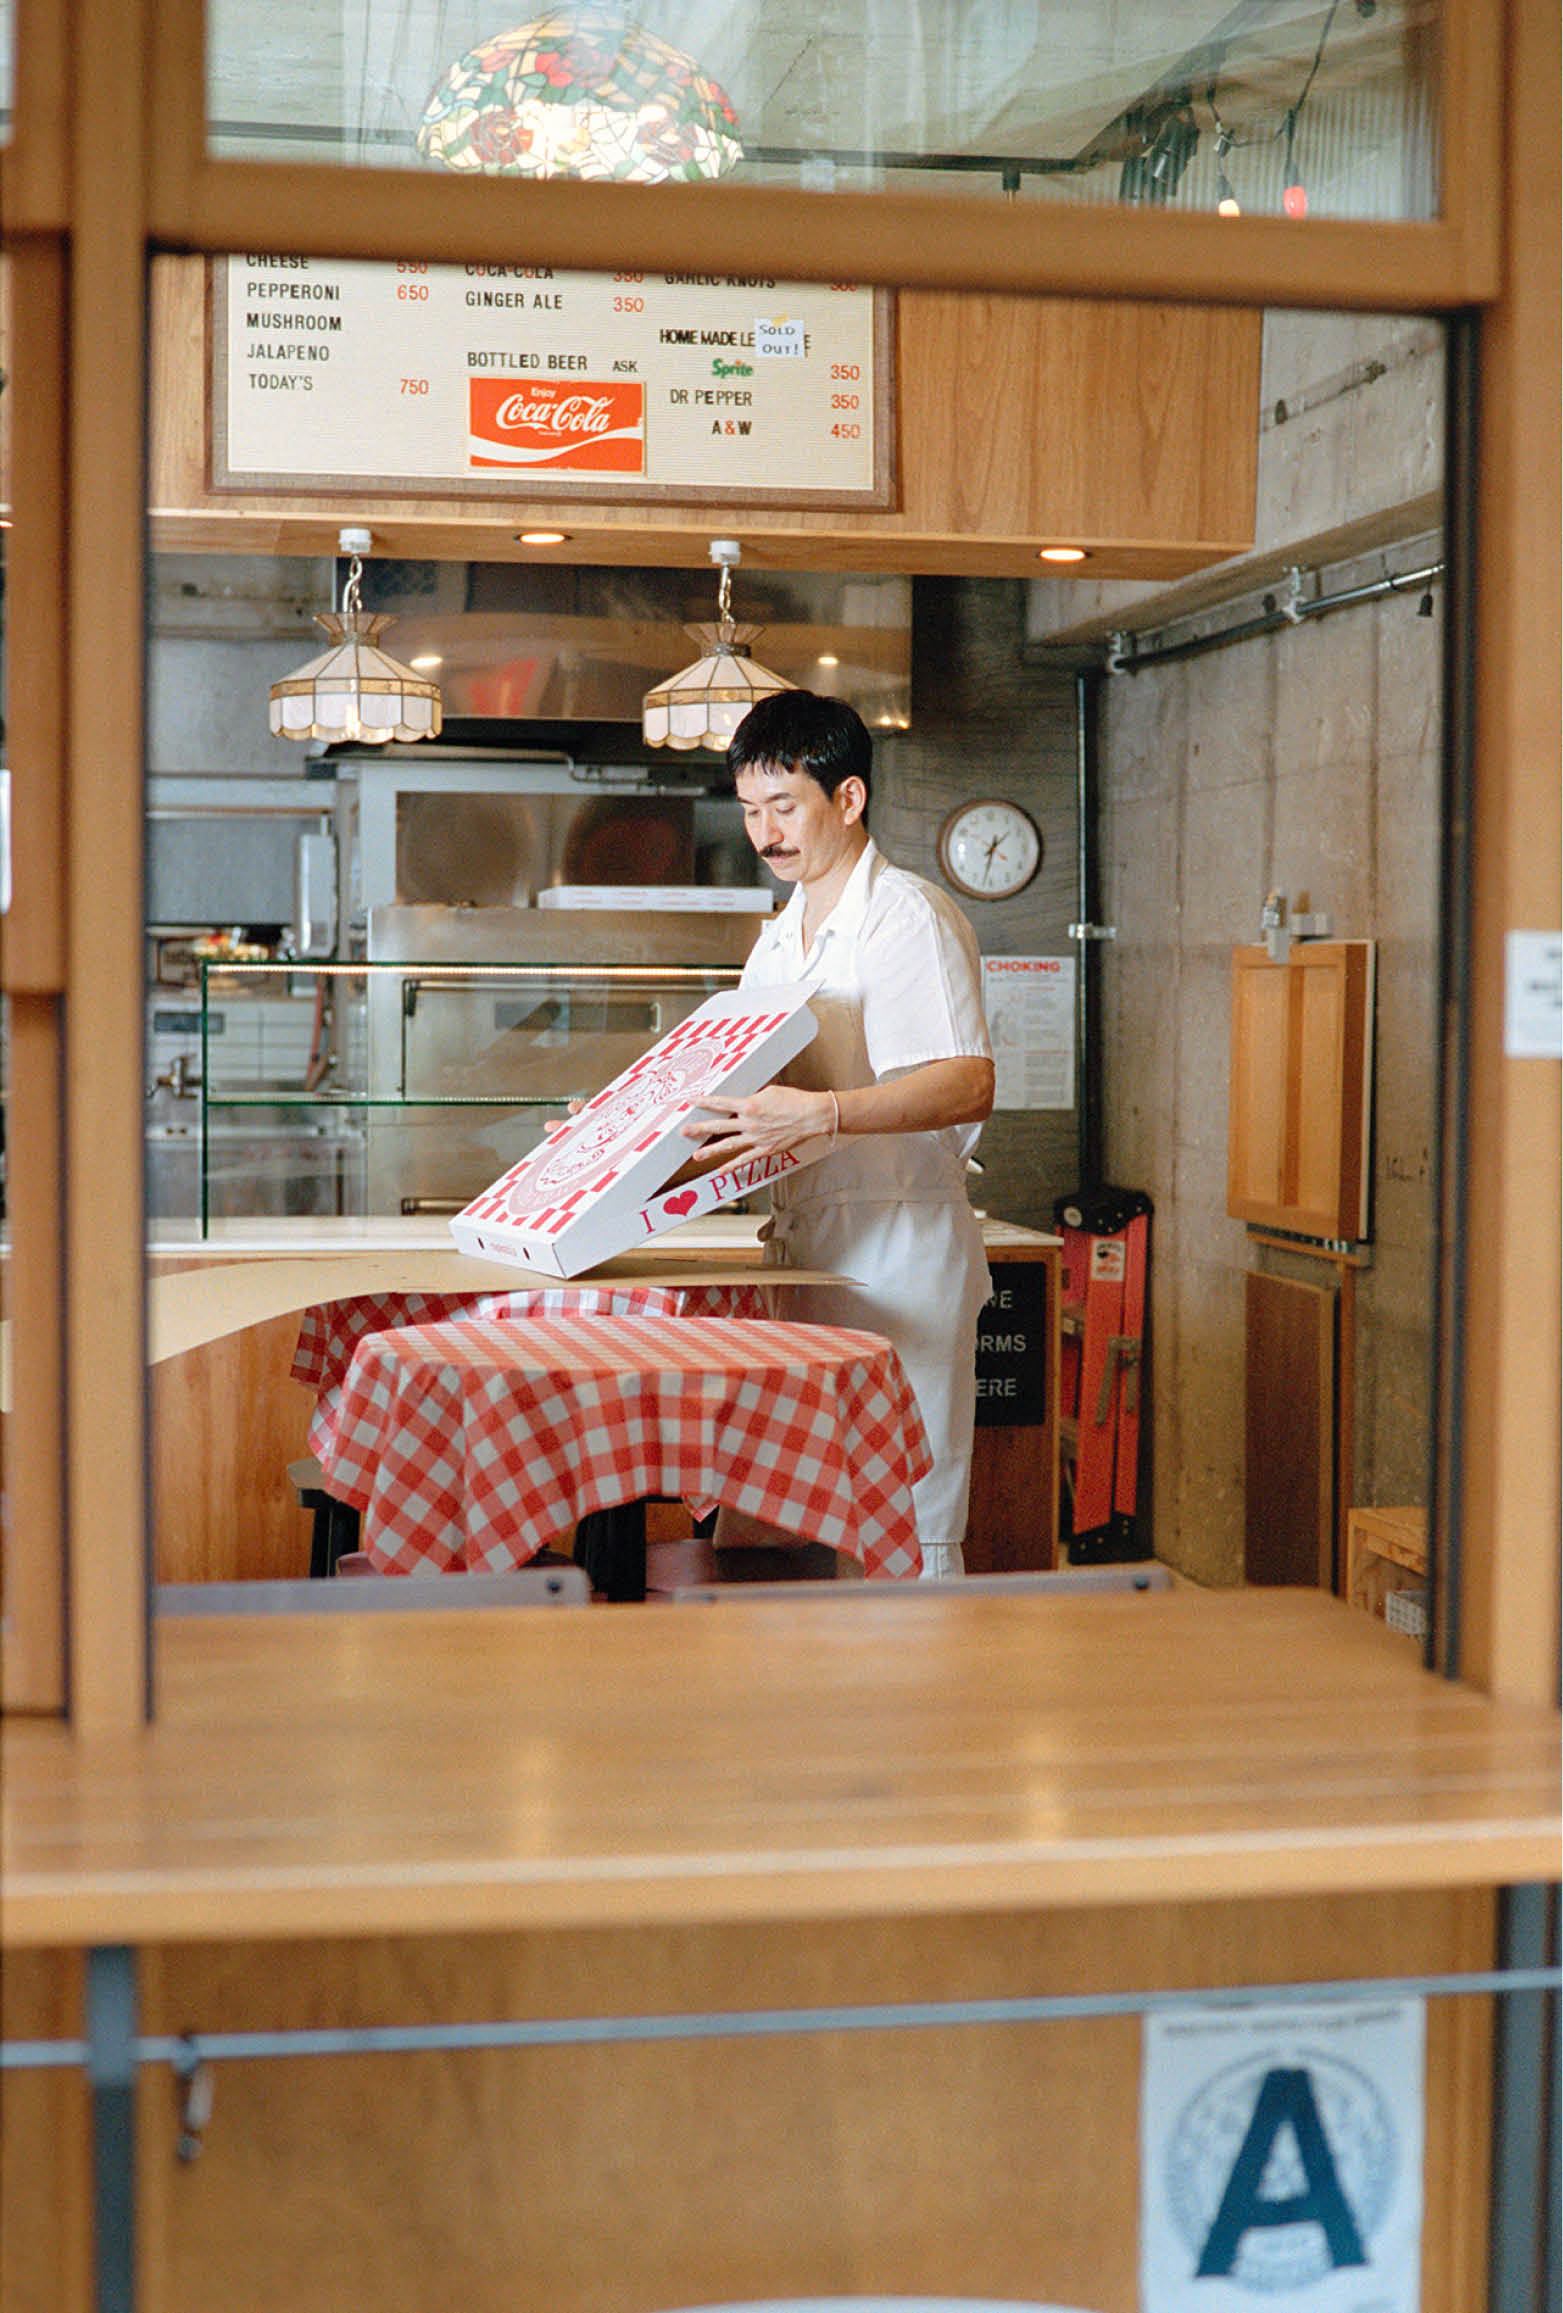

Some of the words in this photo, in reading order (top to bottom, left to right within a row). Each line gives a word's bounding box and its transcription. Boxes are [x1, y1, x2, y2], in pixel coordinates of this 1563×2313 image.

[246, 254, 309, 269] CHEESE
[465, 264, 554, 280] COCA-COLA
[664, 273, 720, 286] GARLIC
[247, 282, 340, 301] PEPPERONI
[397, 285, 429, 301] 650
[465, 291, 525, 308] GINGER
[533, 294, 563, 310] ALE
[613, 296, 644, 313] 350
[246, 312, 342, 331] MUSHROOM
[660, 329, 698, 344] HOME
[701, 331, 737, 347] MADE
[247, 343, 330, 361] JALAPENO
[762, 343, 799, 355] OUT!
[467, 352, 540, 369] BOTTLED
[548, 355, 588, 370] BEER
[612, 360, 638, 373] ASK
[712, 358, 753, 379] Sprite
[830, 364, 860, 381] 350
[249, 373, 313, 391] TODAY'S
[400, 378, 429, 395] 750
[530, 387, 556, 399] Enjoy
[670, 389, 688, 404] DR
[695, 390, 752, 406] PEPPER
[831, 393, 860, 410] 350
[495, 393, 615, 432] Coca-Cola
[831, 423, 861, 440] 450
[985, 960, 1061, 973] CHOKING
[640, 1209, 656, 1234] I
[709, 1150, 800, 1202] PIZZA
[978, 1334, 1026, 1352] RMS
[976, 1378, 1017, 1397] ERE
[1194, 2067, 1369, 2279] A
